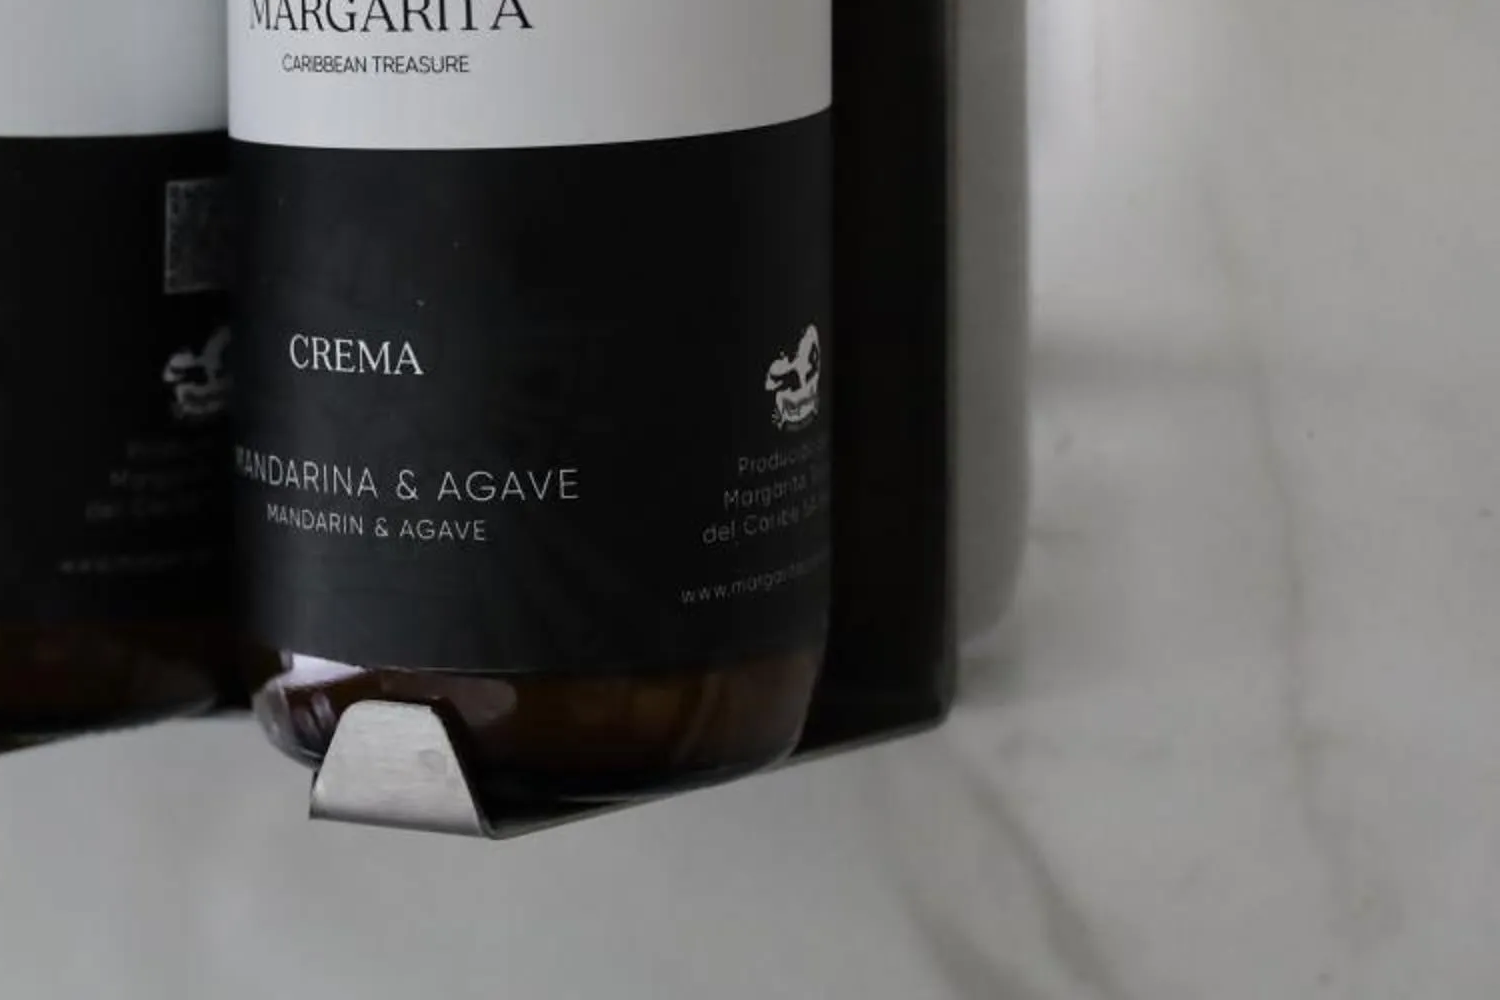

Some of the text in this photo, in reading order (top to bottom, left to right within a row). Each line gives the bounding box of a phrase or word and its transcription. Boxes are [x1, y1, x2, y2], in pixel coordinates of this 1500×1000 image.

[282, 53, 471, 74] CARIBBEAN TREASURE
[289, 333, 425, 376] CREMA
[395, 469, 419, 500] &
[437, 469, 580, 501] AGAVE
[267, 503, 486, 541] MANDARIN & AGAVE
[702, 520, 736, 545] del
